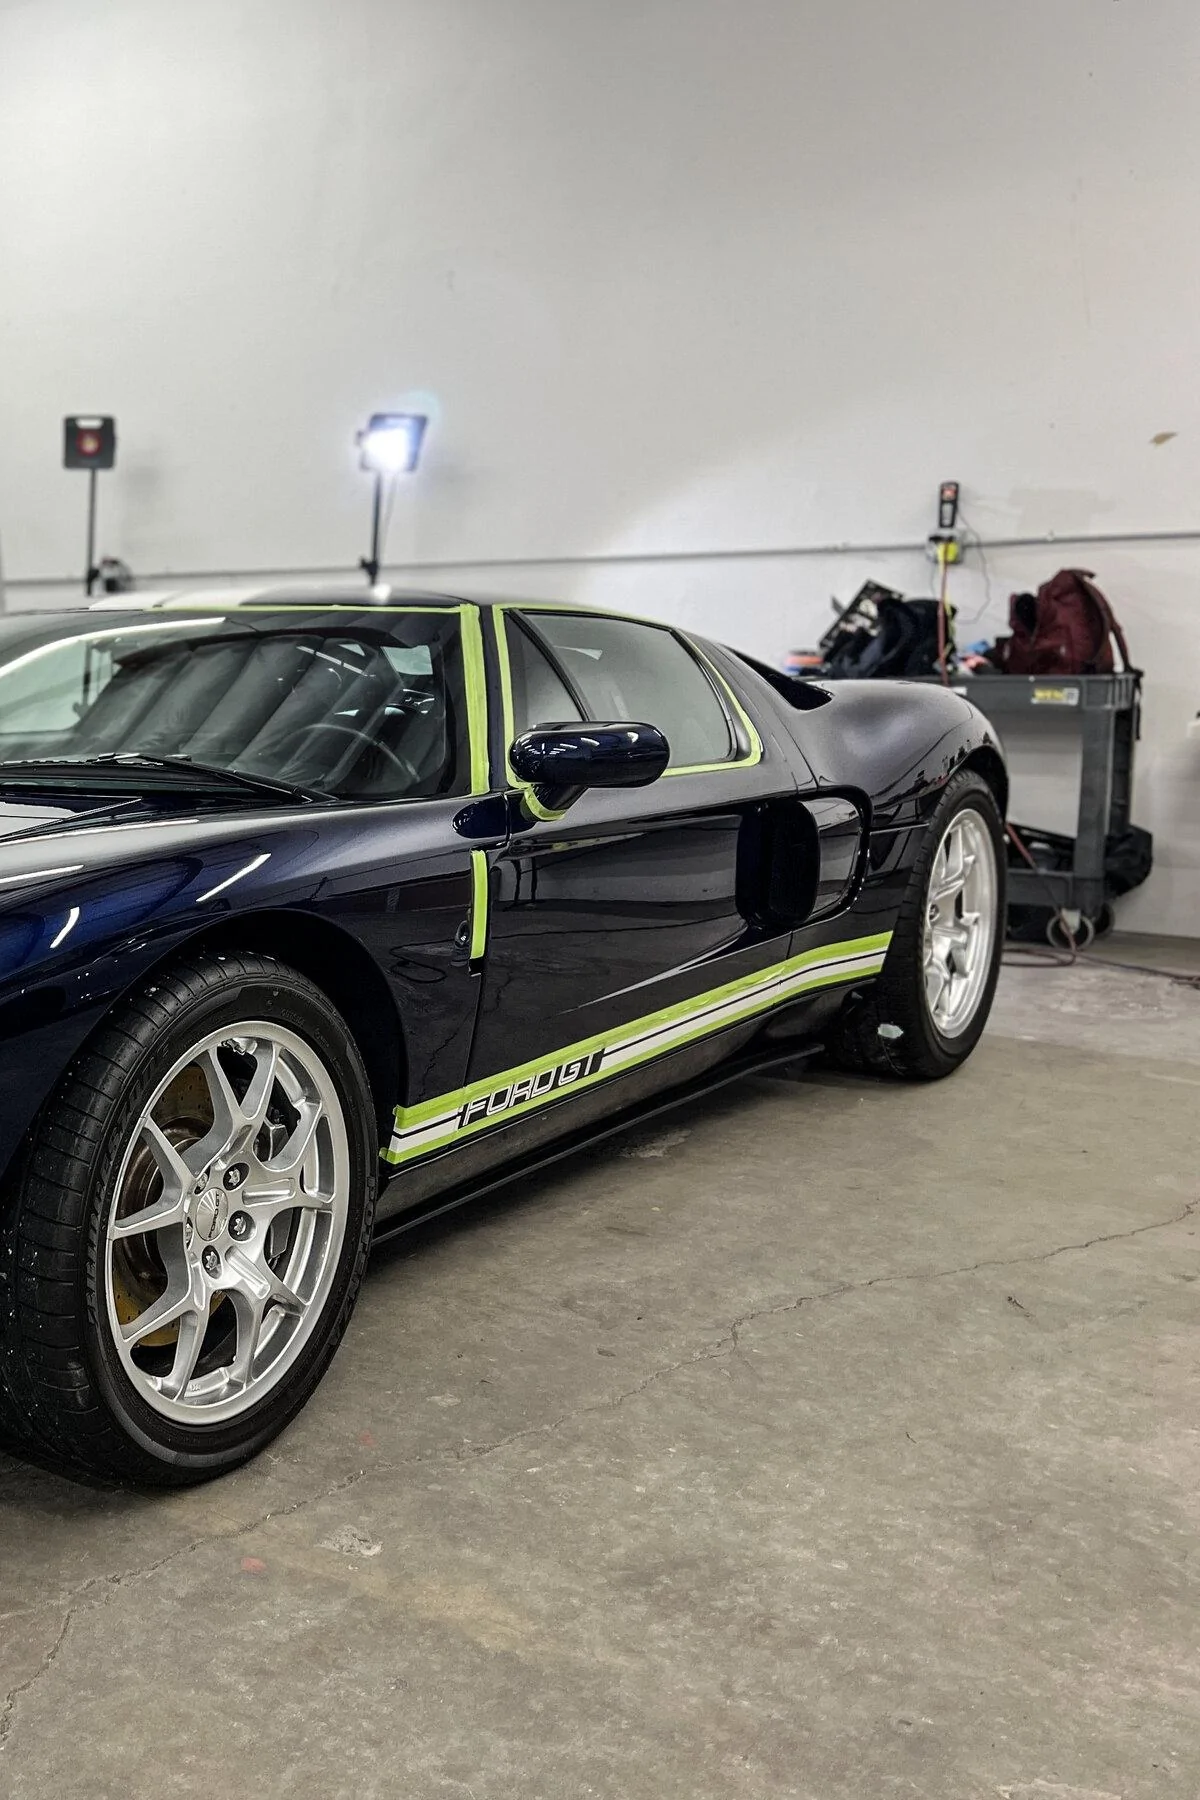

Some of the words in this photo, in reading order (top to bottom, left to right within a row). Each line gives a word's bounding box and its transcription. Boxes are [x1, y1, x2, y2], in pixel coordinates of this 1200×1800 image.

[462, 1066, 557, 1126] FORD
[558, 1051, 603, 1086] GT
[208, 1208, 219, 1238] FORD
